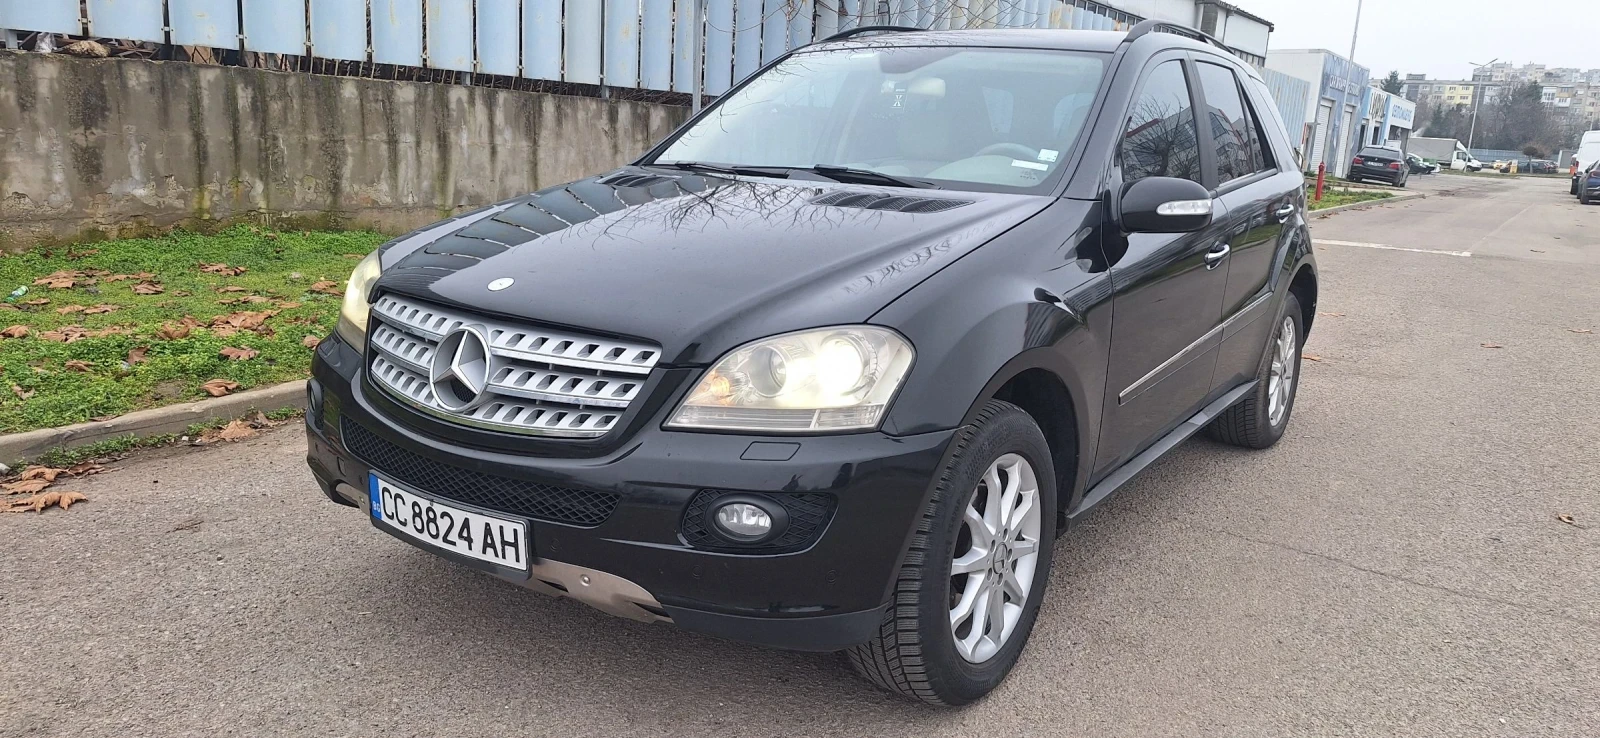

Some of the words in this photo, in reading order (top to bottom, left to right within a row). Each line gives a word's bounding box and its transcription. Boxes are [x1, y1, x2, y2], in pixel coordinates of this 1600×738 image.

[381, 486, 407, 527] CC
[411, 501, 473, 551] 8824
[482, 522, 520, 563] AH
